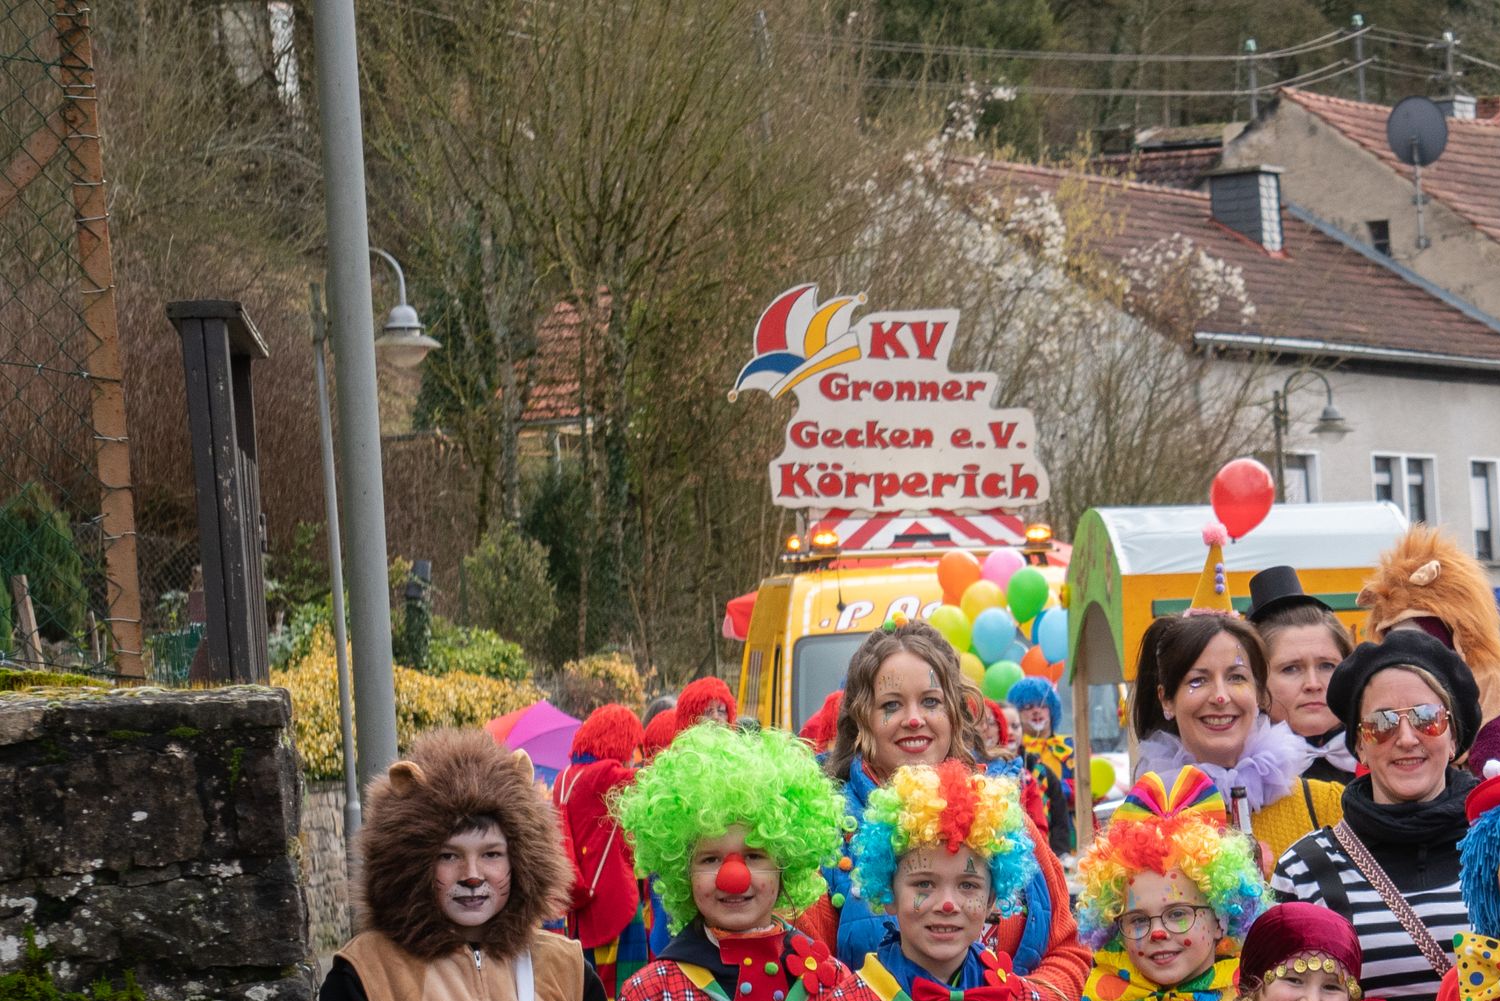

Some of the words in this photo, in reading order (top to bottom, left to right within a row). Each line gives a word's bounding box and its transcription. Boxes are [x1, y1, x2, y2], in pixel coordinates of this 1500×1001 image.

[867, 320, 949, 360] KV
[819, 372, 987, 402] Gronner
[789, 420, 934, 449] Gecken
[950, 422, 1027, 449] e.V.
[777, 462, 1039, 507] Körperich
